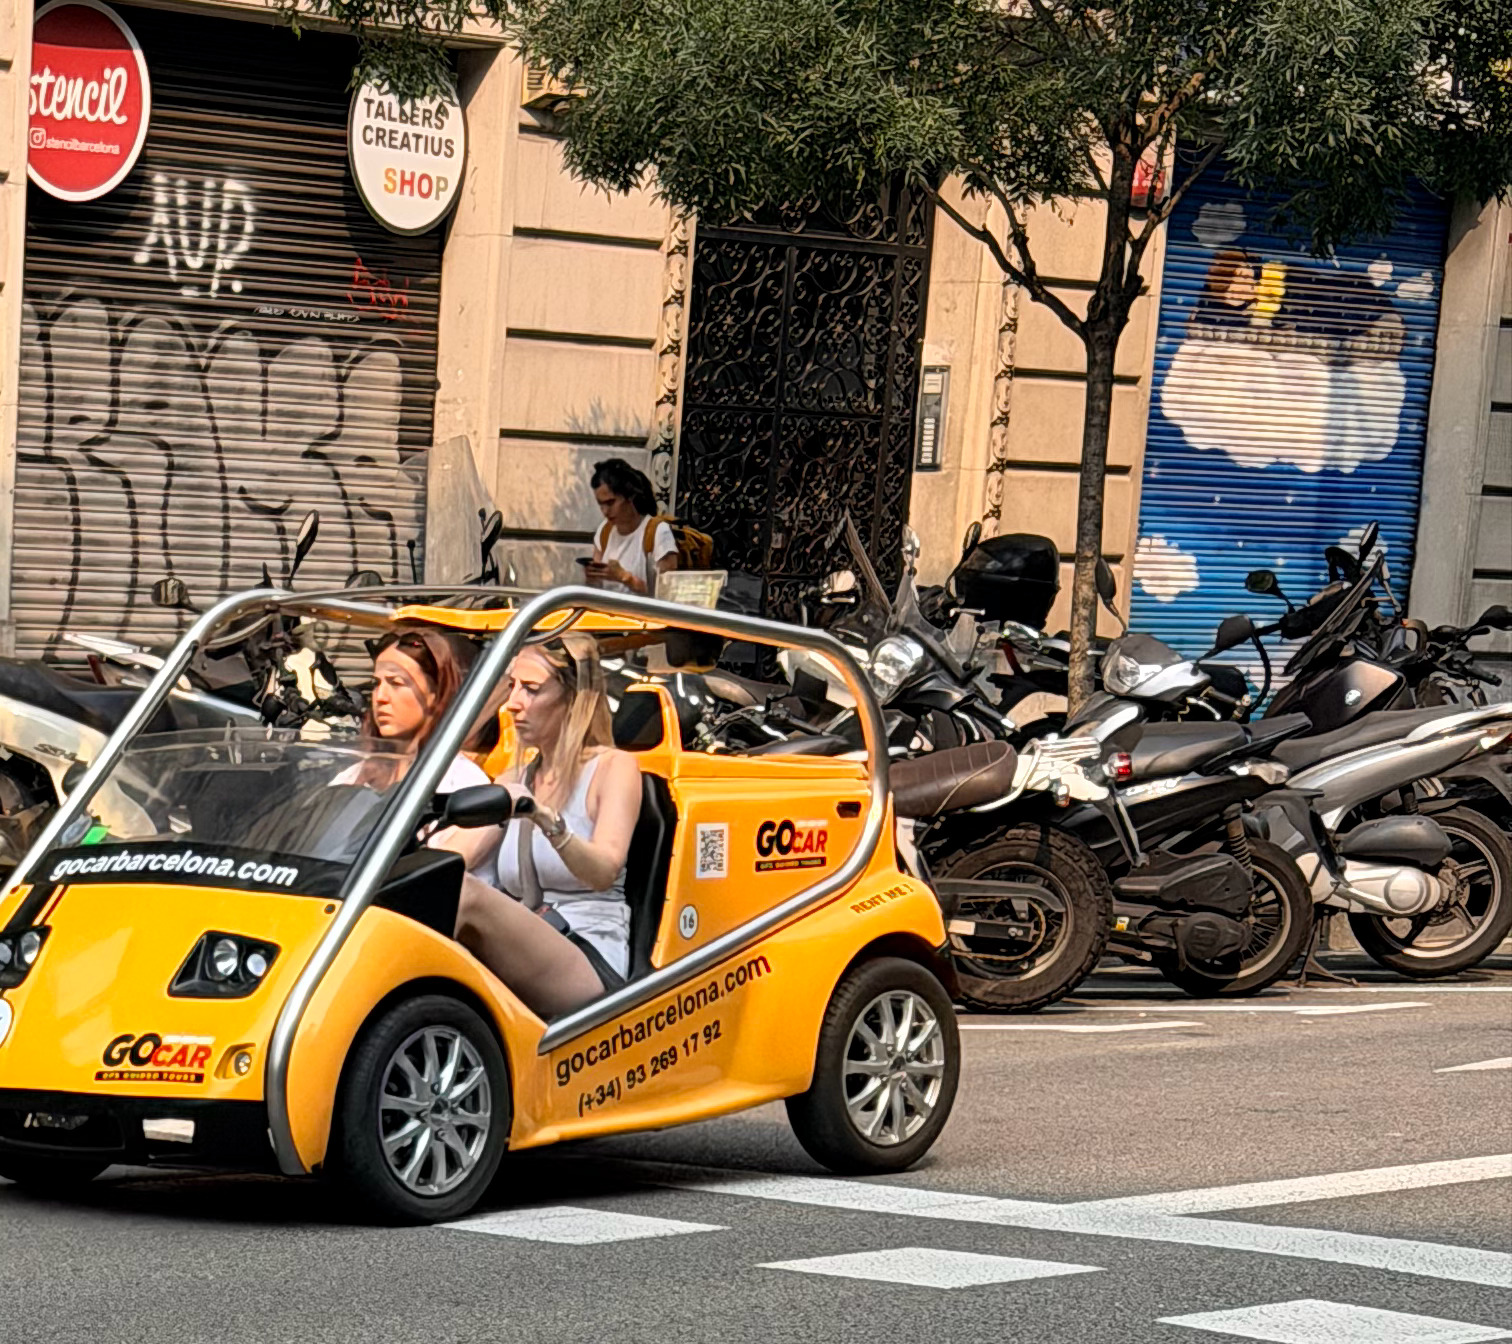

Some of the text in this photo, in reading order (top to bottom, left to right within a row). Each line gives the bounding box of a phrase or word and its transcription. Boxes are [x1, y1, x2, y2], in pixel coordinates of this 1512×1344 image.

[363, 97, 446, 131] TALLERS
[362, 124, 455, 159] CREATIUS
[383, 167, 449, 201] SHOP
[48, 850, 299, 887] gocarbarcelona.com
[682, 912, 695, 930] 16
[555, 955, 772, 1087] gocarbarcelona.com
[578, 1019, 722, 1118] (+34) 93 269 17 92
